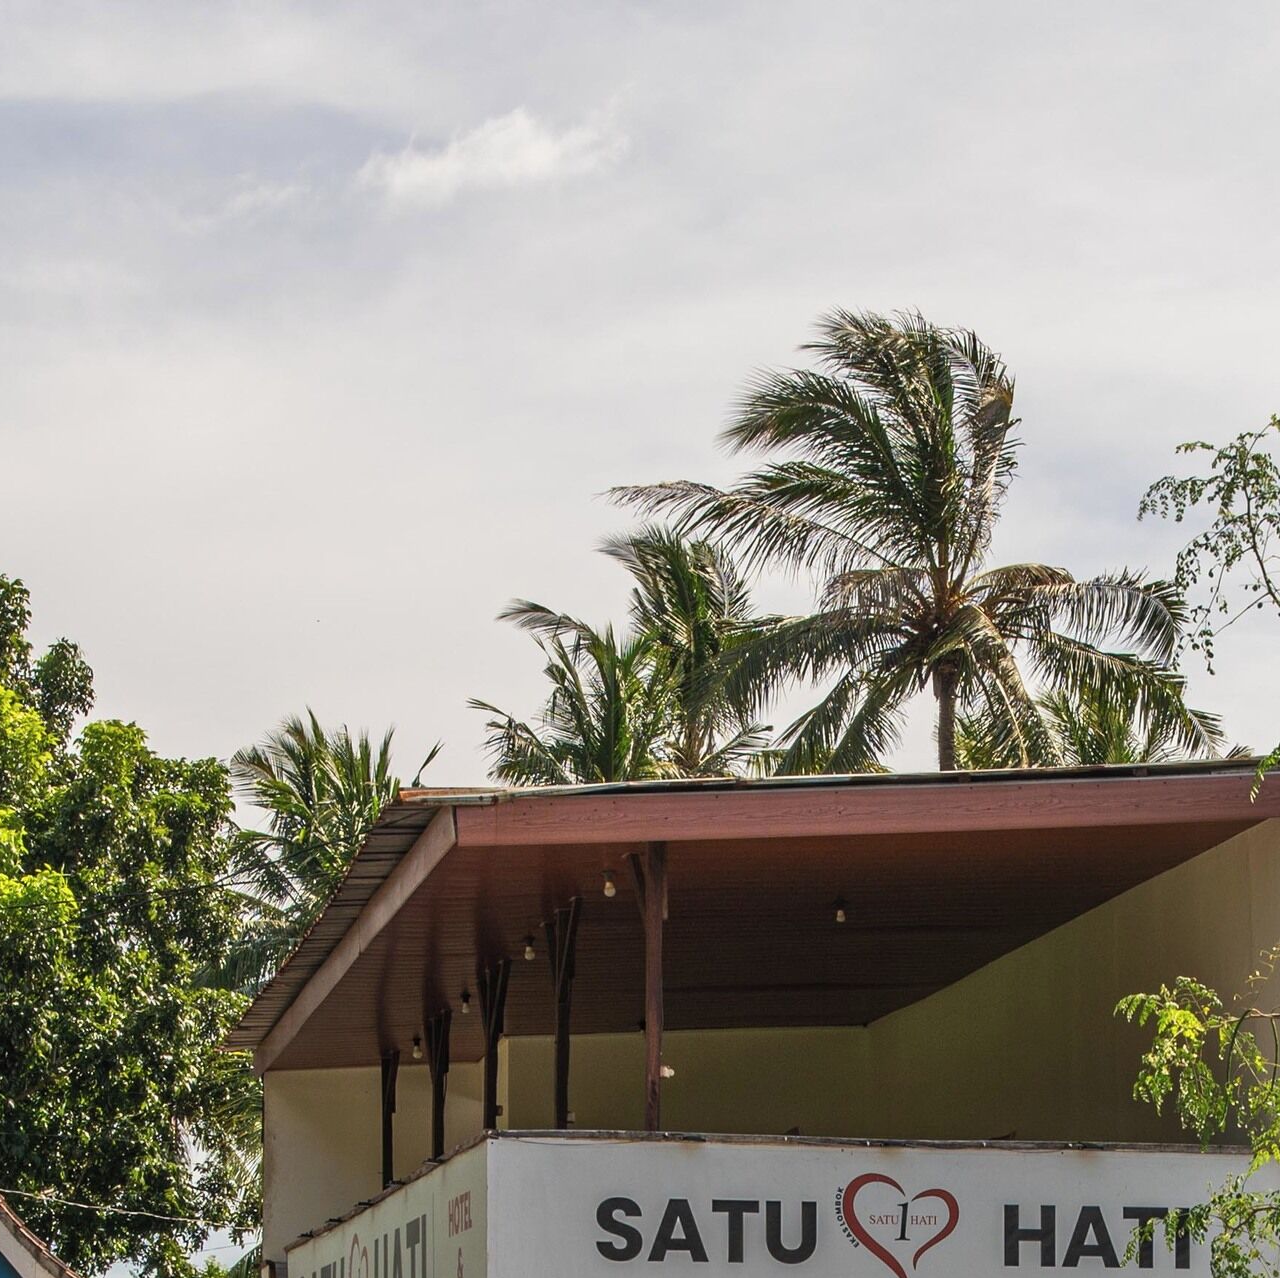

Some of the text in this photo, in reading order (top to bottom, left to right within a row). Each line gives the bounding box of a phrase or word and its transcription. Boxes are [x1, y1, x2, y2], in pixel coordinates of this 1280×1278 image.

[448, 1190, 472, 1238] HOTEL
[596, 1197, 1190, 1269] SATU HATI
[835, 1187, 860, 1248] EKAS LOMBOK
[869, 1201, 938, 1241] SATU 1 HATI
